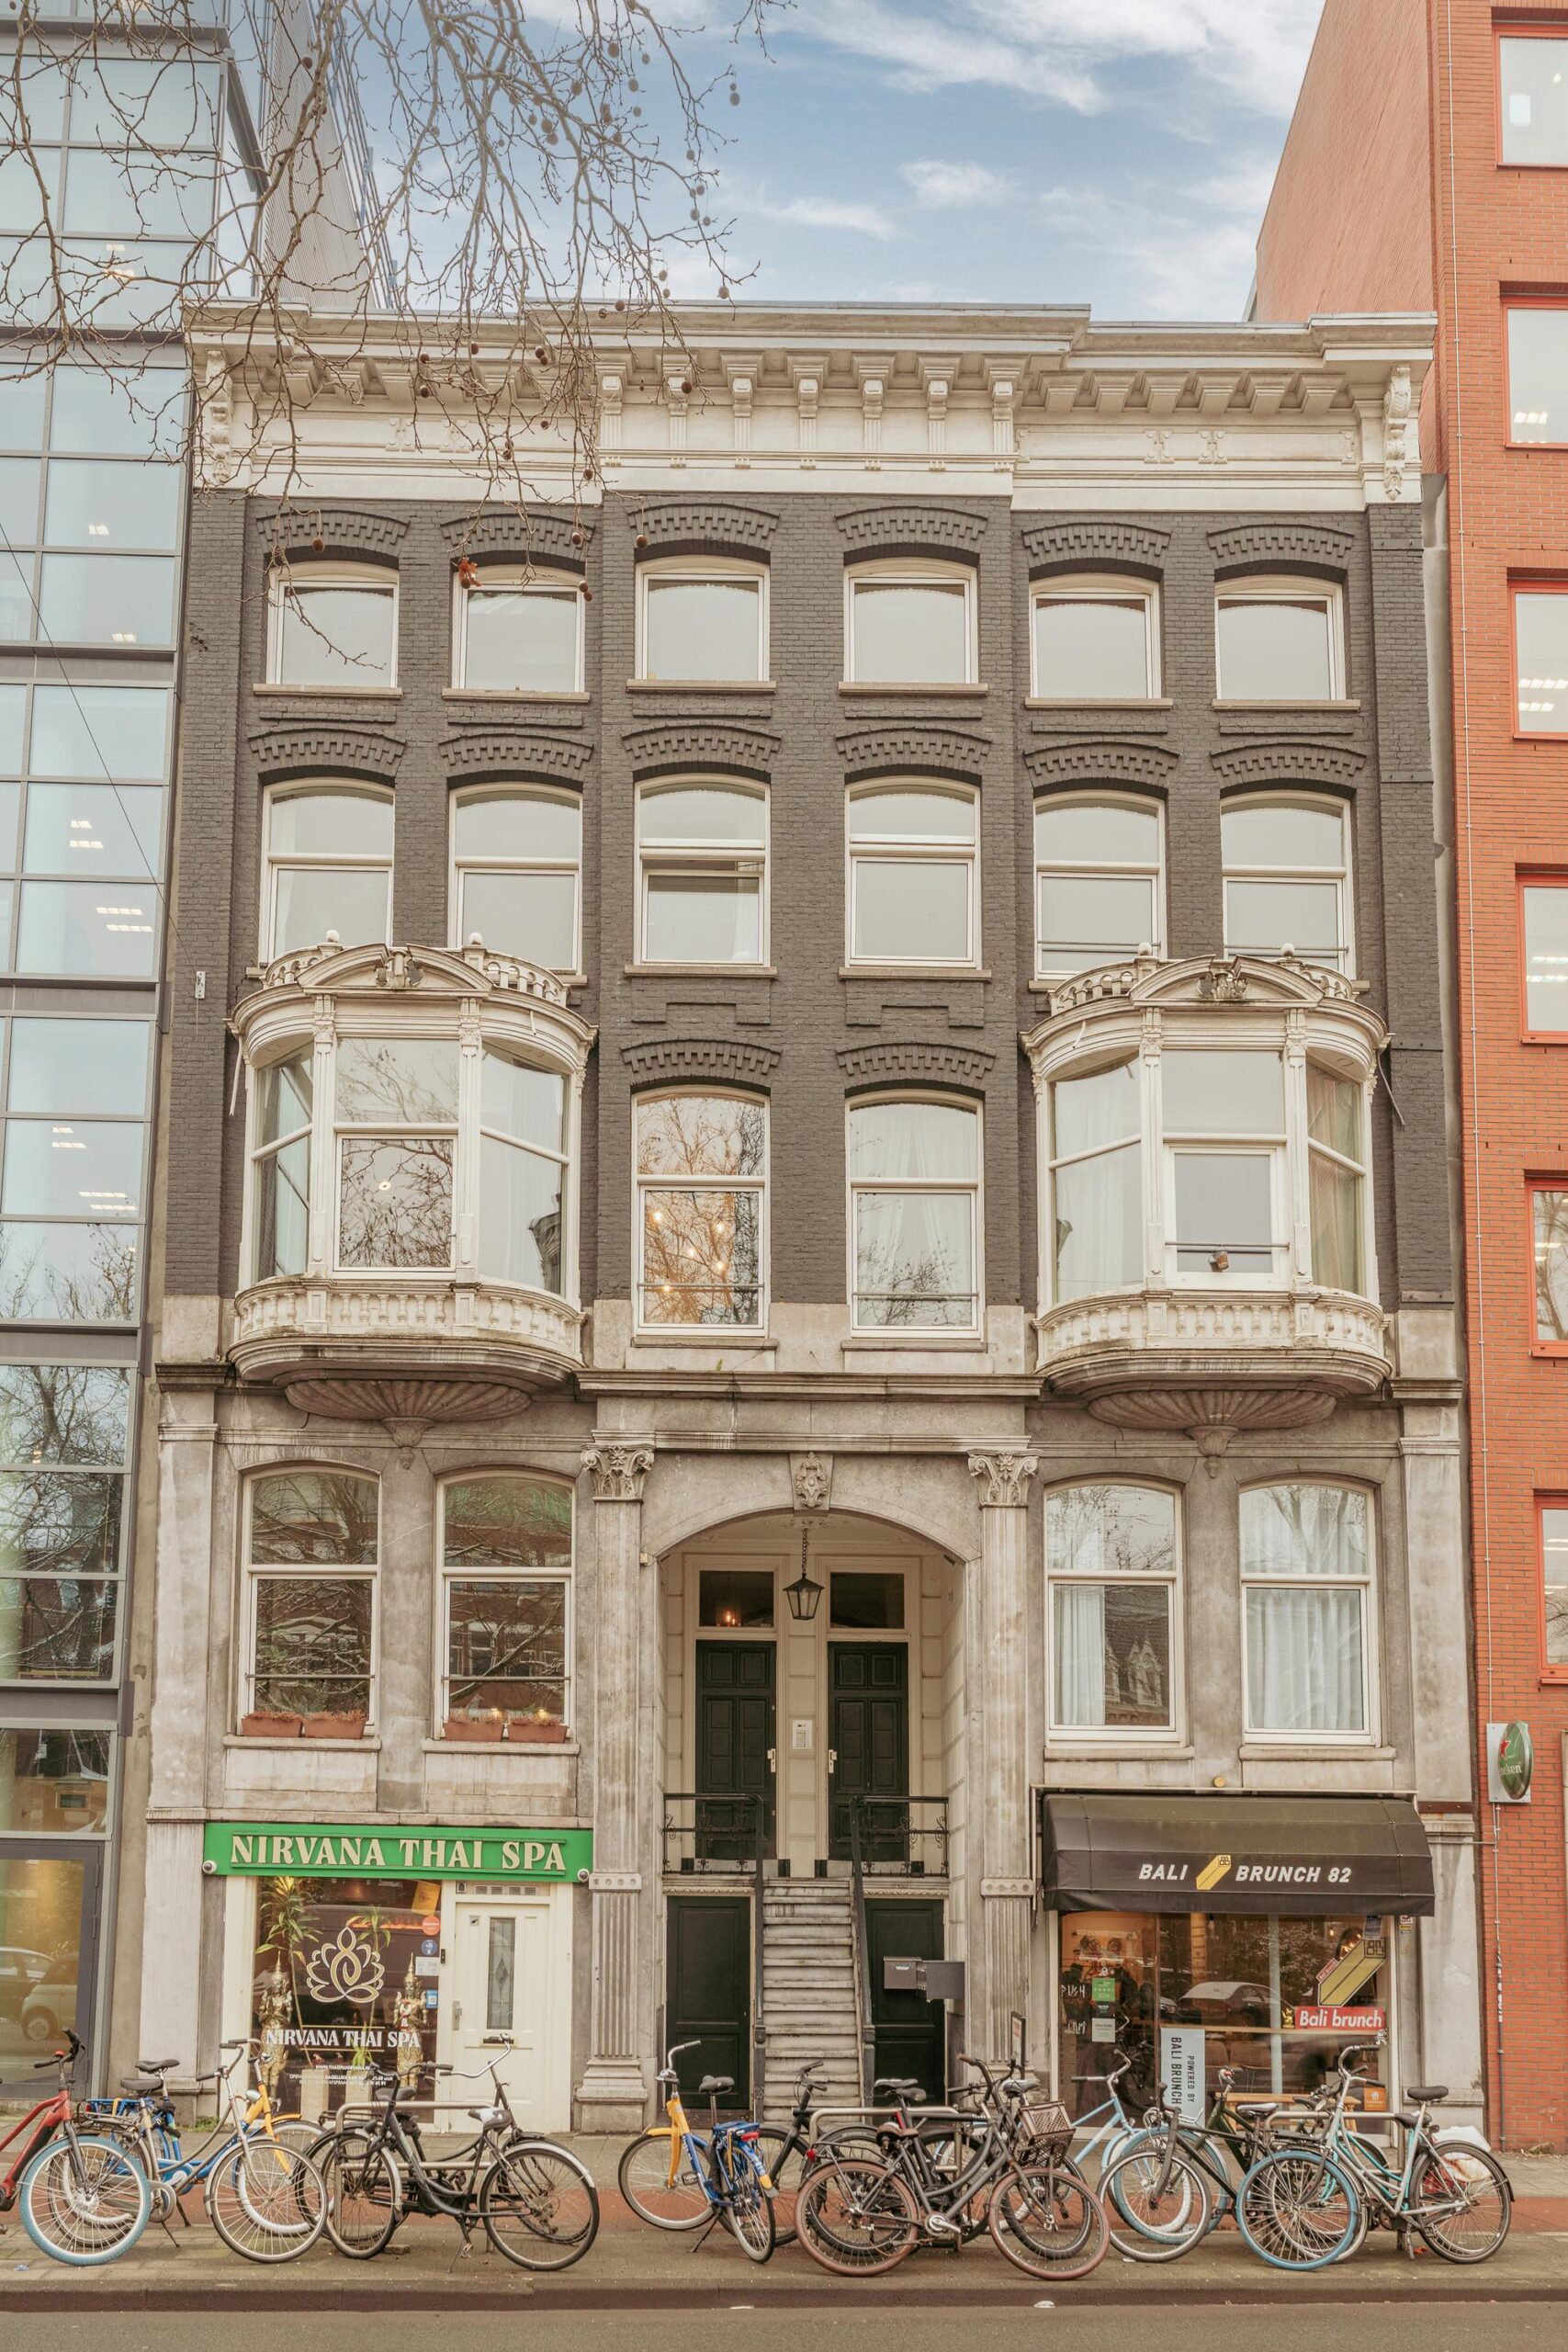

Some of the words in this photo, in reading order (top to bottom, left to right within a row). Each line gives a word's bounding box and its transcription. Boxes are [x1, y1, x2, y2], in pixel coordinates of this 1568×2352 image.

[231, 1835, 386, 1867] NIRVANA
[399, 1838, 483, 1869] THAI
[502, 1841, 567, 1871] SPA
[1138, 1863, 1189, 1882] BALI
[1235, 1865, 1321, 1883] BRUNCH
[1327, 1867, 1353, 1883] 82
[1299, 2008, 1328, 2028] Bali
[1332, 2009, 1382, 2029] brunch
[265, 2029, 340, 2047] NIRVANA
[343, 2030, 383, 2048] THAI
[387, 2031, 421, 2048] SPA
[1171, 2037, 1182, 2059] BALI
[1171, 2064, 1182, 2104] BRUNCH
[1188, 2094, 1195, 2103] BY
